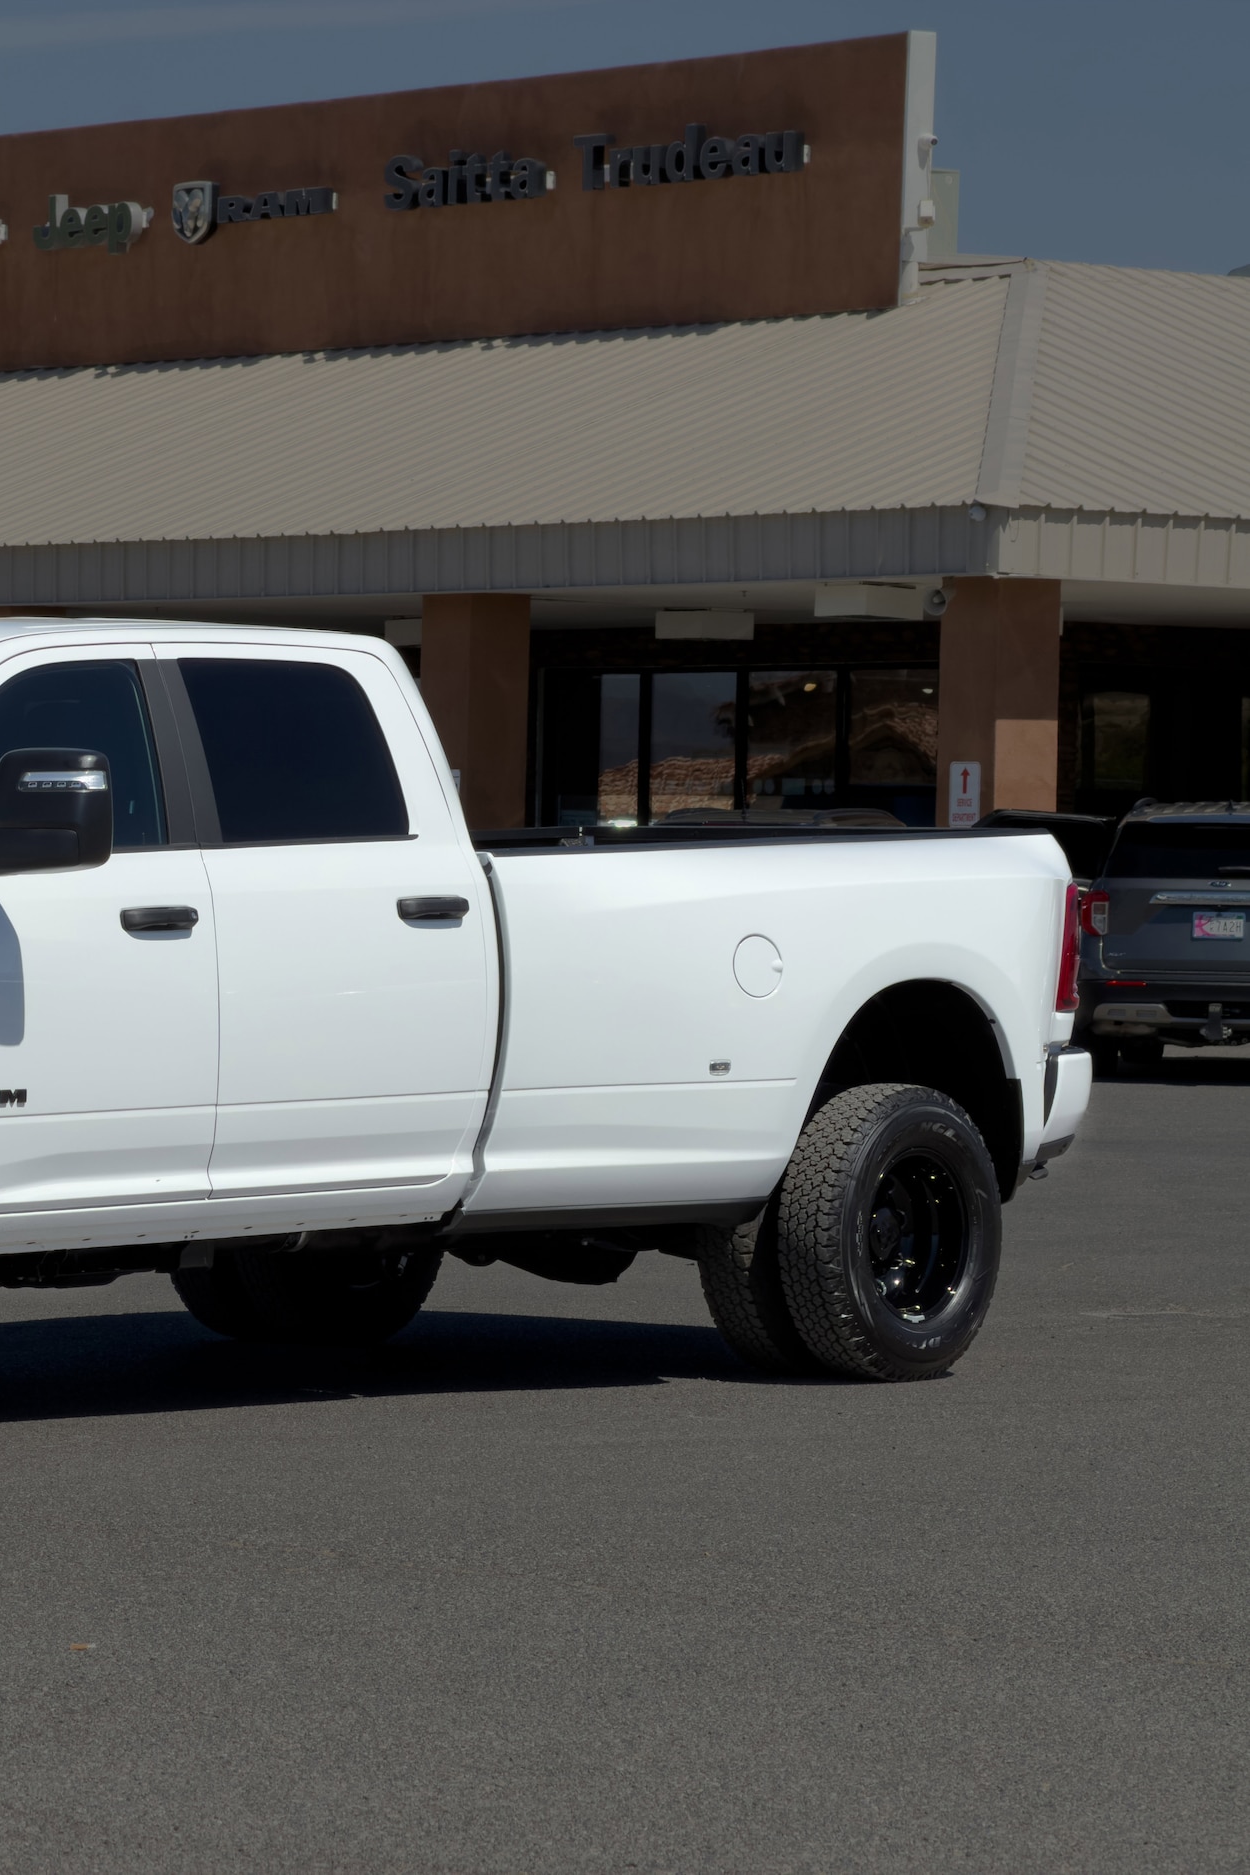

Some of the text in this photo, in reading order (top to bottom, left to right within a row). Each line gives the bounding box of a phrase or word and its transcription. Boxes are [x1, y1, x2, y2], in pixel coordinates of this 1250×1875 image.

[385, 124, 804, 211] Saitta Trudeau
[33, 195, 139, 254] Jeep
[217, 187, 333, 223] RAM
[957, 798, 972, 807] SERVICE
